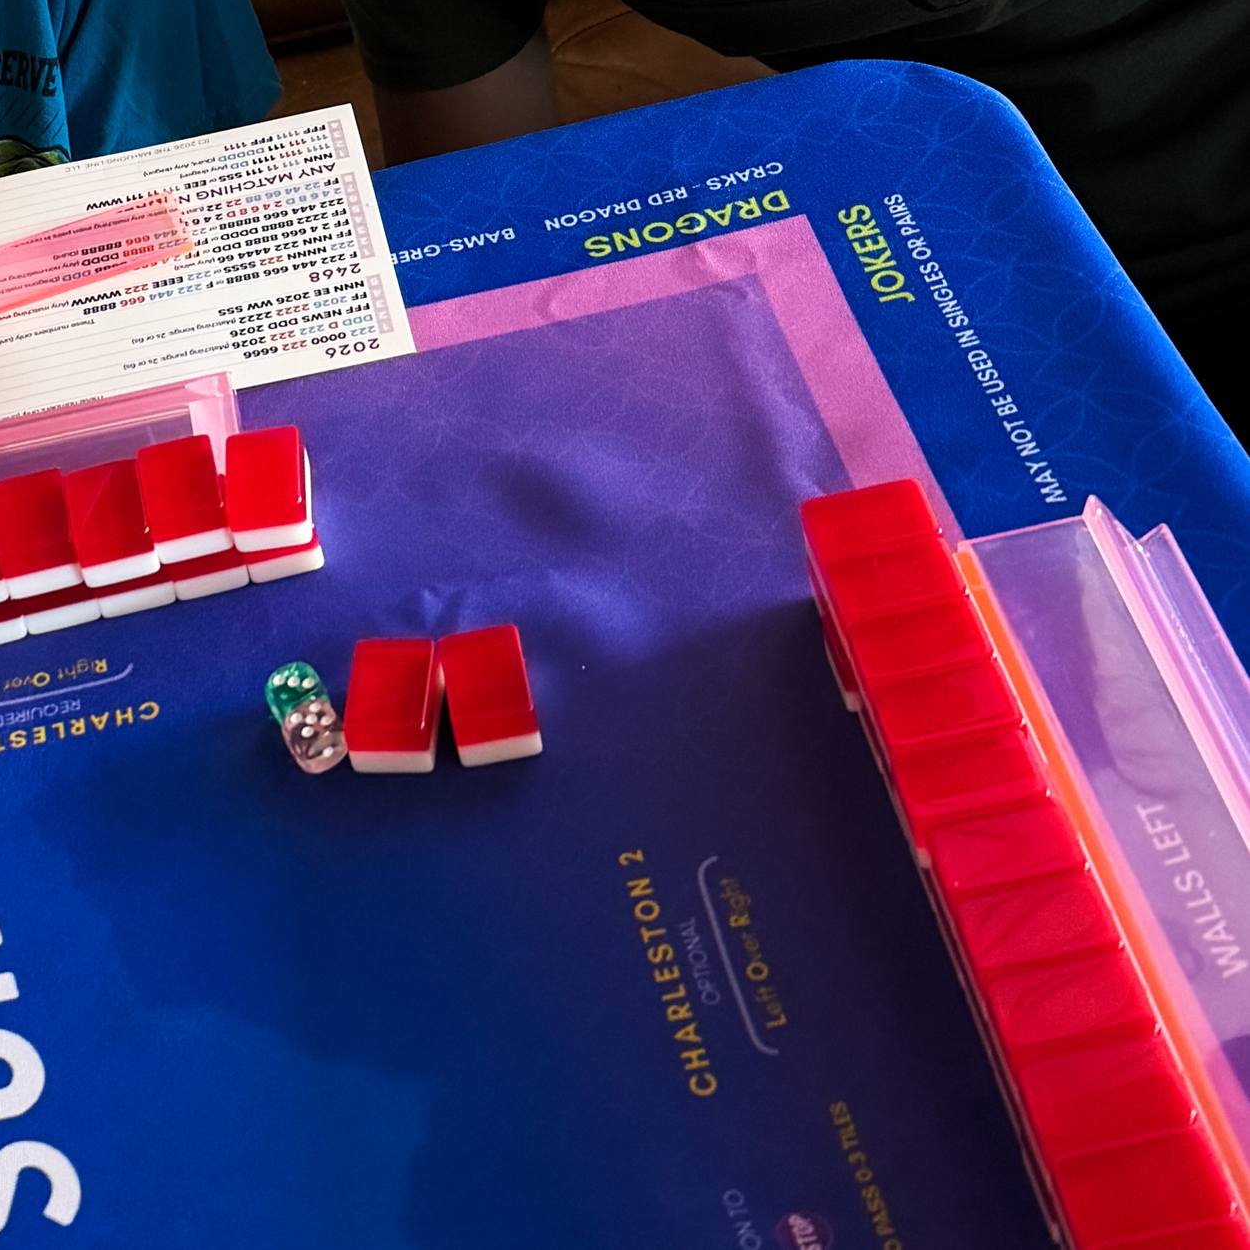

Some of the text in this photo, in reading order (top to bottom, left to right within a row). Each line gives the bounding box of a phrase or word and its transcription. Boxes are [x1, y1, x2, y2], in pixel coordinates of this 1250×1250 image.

[195, 162, 335, 200] ANY MATCHING
[544, 162, 783, 232] CRAKS RED DRAGON
[584, 190, 791, 259] DRAGONS
[291, 260, 317, 270] 444
[320, 253, 345, 264] 222
[349, 250, 357, 258] F
[838, 204, 915, 303] JOKERS
[71, 239, 354, 307] 222 NNNN 222 SSSS 222 EEEE 222 WWWW
[206, 280, 213, 288] F
[262, 265, 288, 276] 666
[308, 262, 361, 282] 2468
[119, 295, 145, 307] 666
[148, 290, 173, 300] 444
[177, 283, 202, 294] 222
[217, 280, 364, 316] NNN EE 2026 WW SSS
[229, 302, 370, 337] FFF NEWS DDD 2026
[238, 291, 367, 323] FF 2026 2222 2222
[231, 313, 373, 349] DDD D 222 222 2026
[243, 325, 375, 358] 222 0000 222 6666
[325, 337, 379, 358] 2026
[884, 194, 1067, 504] MAY NOT BE USED IN SINGLES OR PAIRS
[3, 672, 50, 695] Over
[58, 658, 108, 681] Right
[1136, 804, 1248, 978] WALLS LEFT
[618, 849, 717, 1097] CHARLESTON 2
[679, 917, 721, 1006] OPTIONAL
